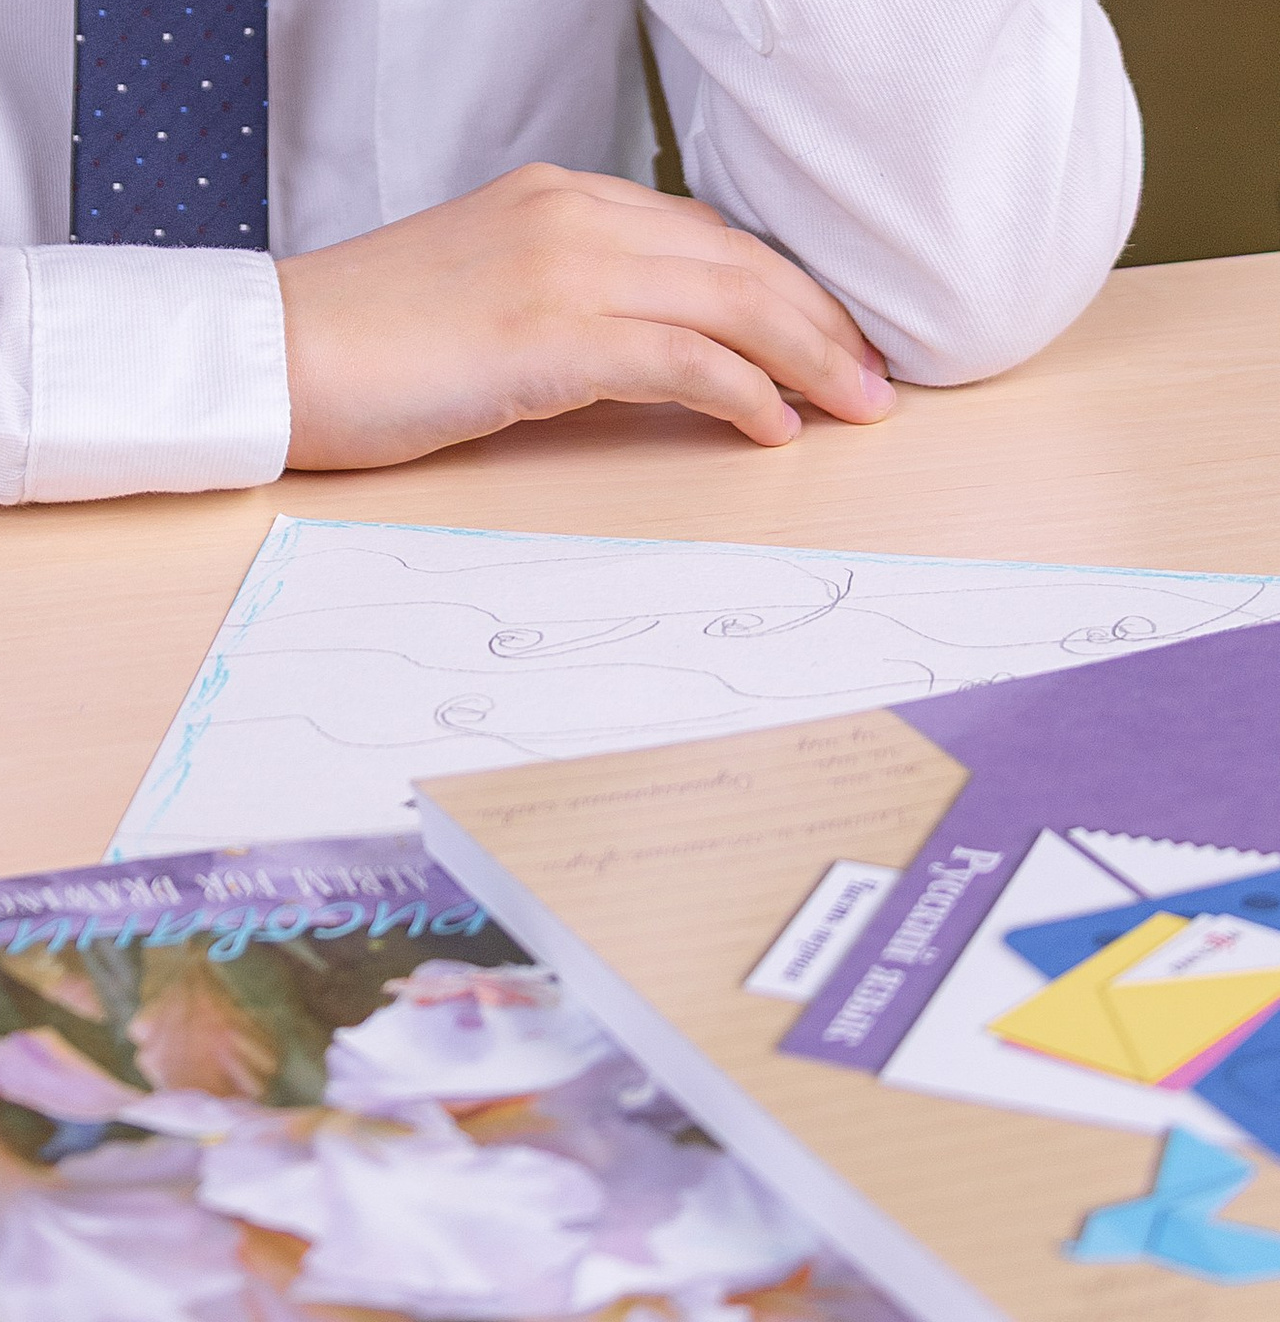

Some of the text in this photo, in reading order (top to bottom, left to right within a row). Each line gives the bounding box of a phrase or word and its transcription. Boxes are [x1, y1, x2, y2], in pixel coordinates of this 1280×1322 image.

[198, 867, 272, 904] FOR
[820, 844, 1005, 1047] Русский язык
